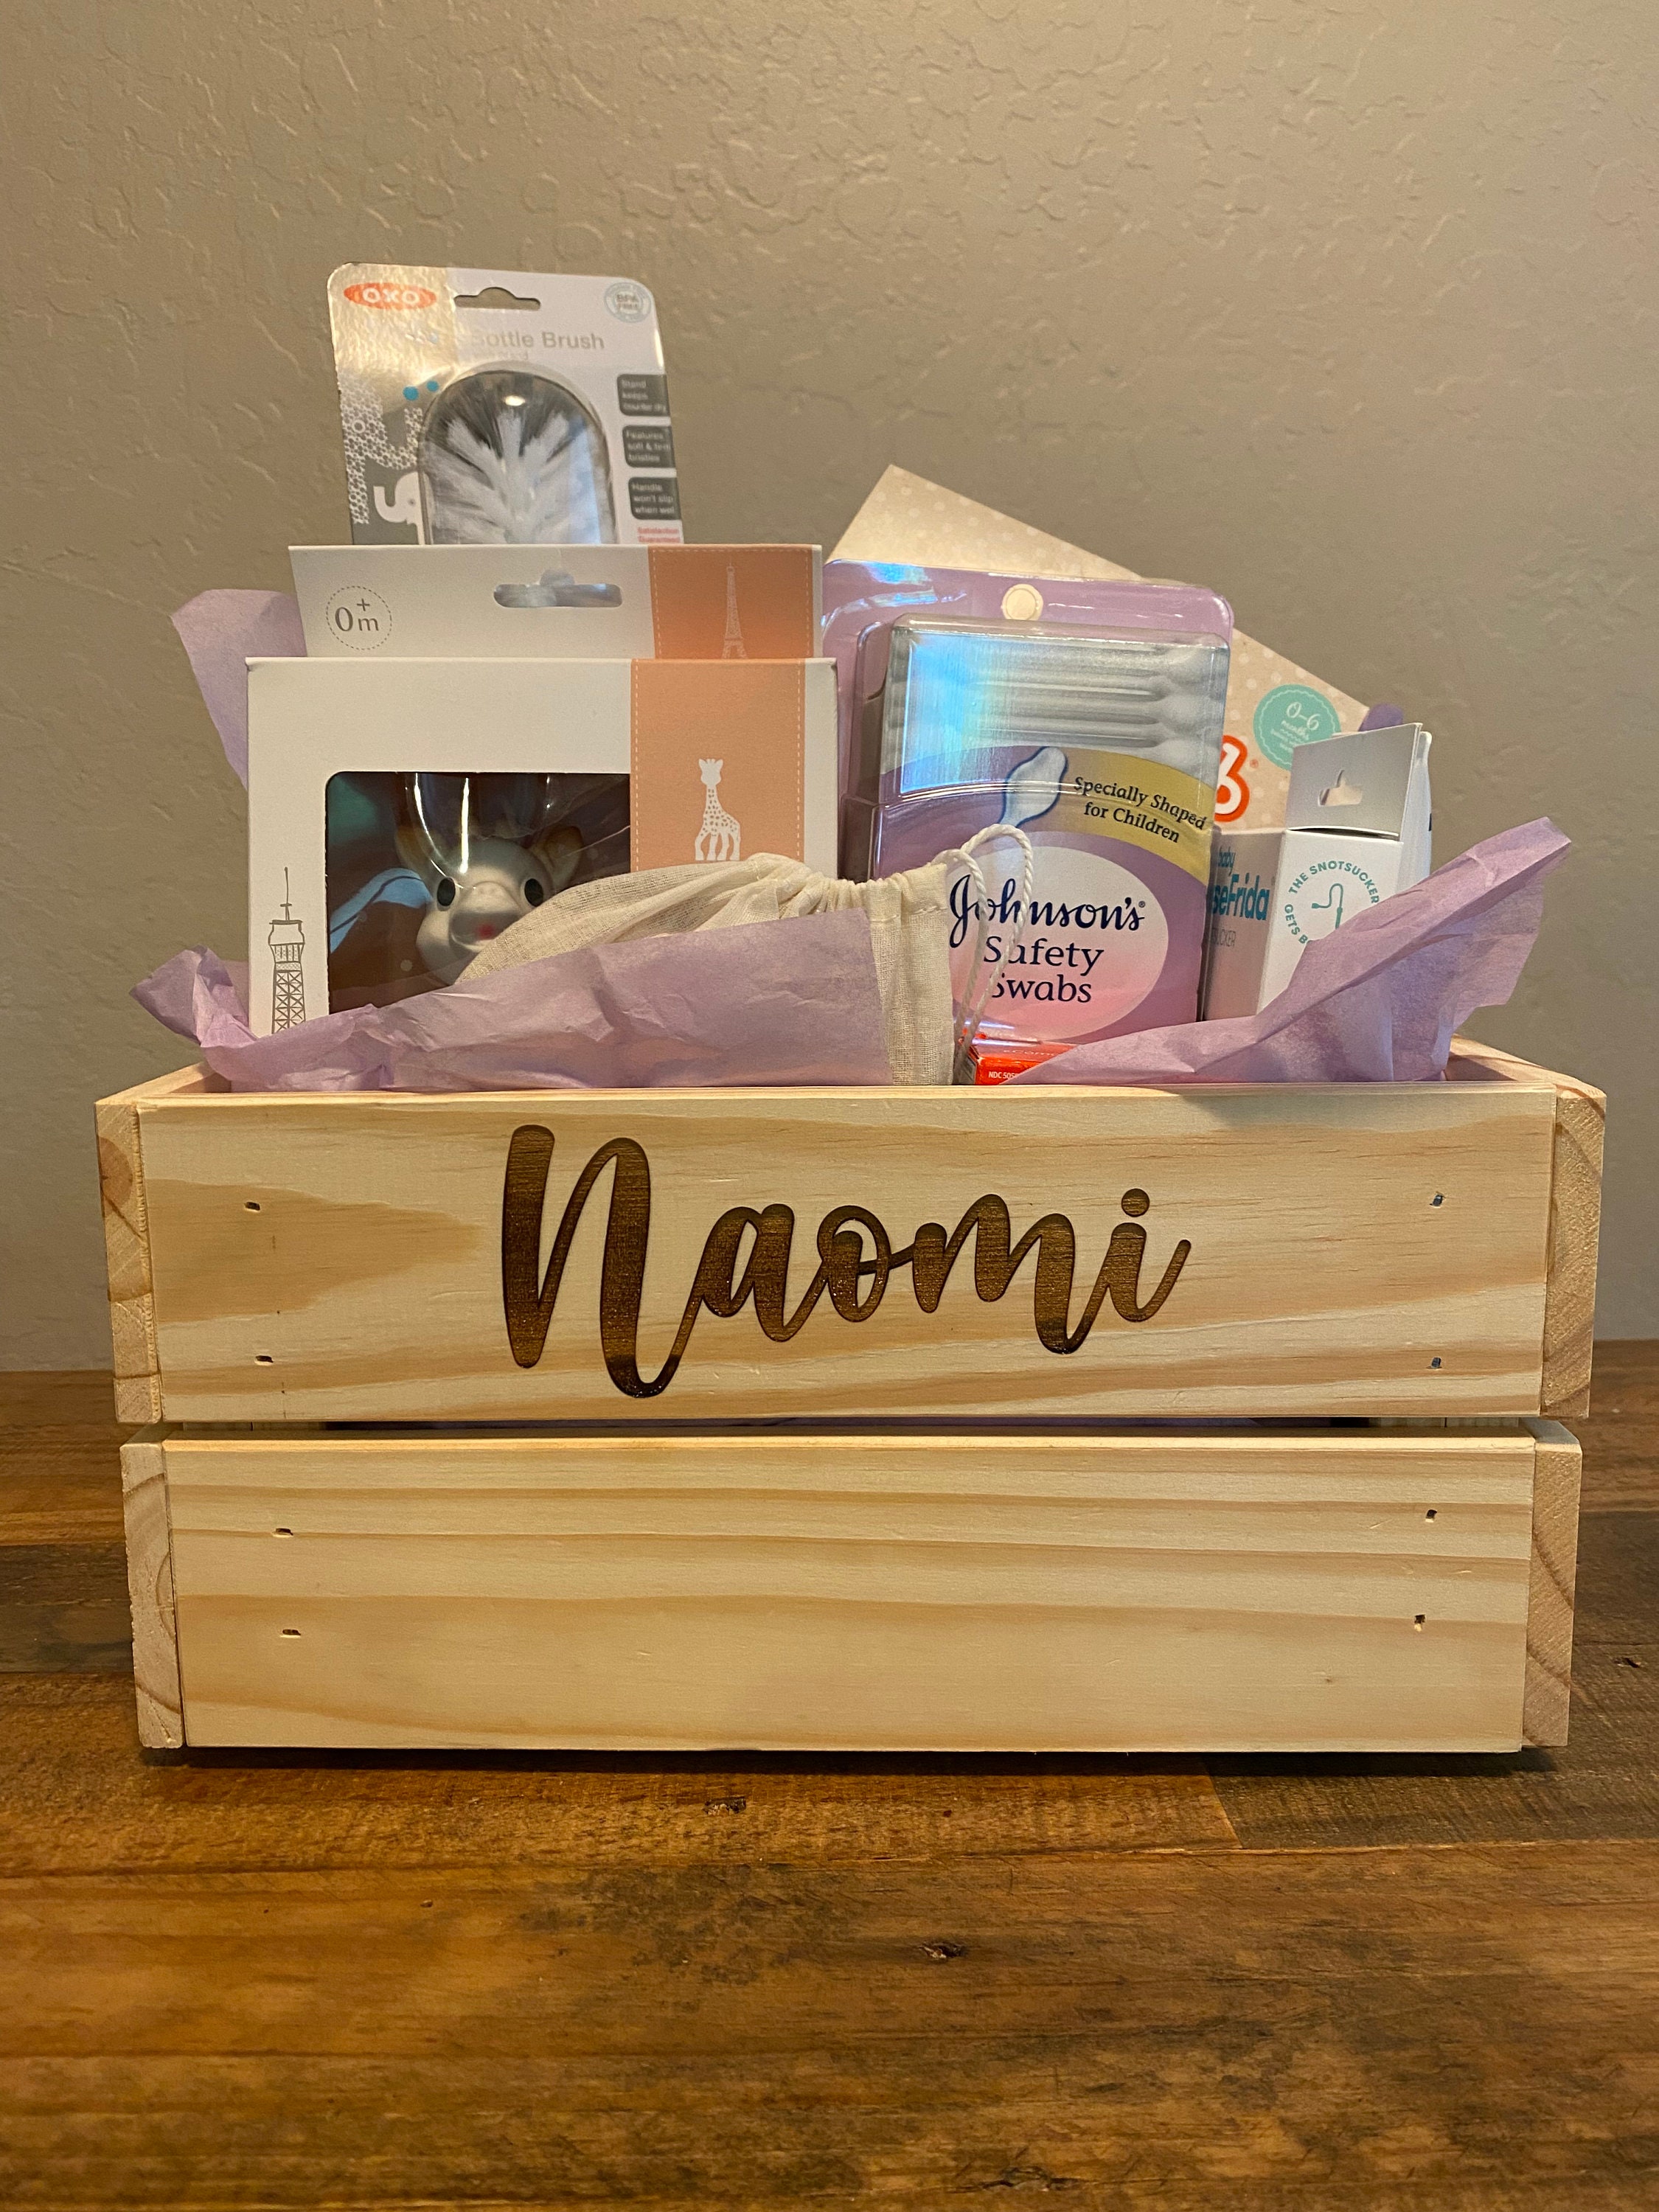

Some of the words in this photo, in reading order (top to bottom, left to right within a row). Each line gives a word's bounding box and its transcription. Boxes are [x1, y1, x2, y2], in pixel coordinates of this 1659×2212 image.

[362, 287, 420, 305] OXO
[542, 332, 605, 349] Brush
[1074, 776, 1149, 807] Specially
[1150, 794, 1207, 830] Shaped
[1084, 801, 1109, 818] for
[1113, 807, 1180, 844] Children
[1212, 872, 1270, 921] seFrida
[1288, 872, 1309, 894] THE
[1309, 860, 1380, 904] SNOTSUCKER
[949, 874, 1145, 948] Johnson's
[1284, 904, 1301, 935] GETS
[983, 936, 1105, 976] Safety
[502, 1124, 1192, 1399] Naomi
